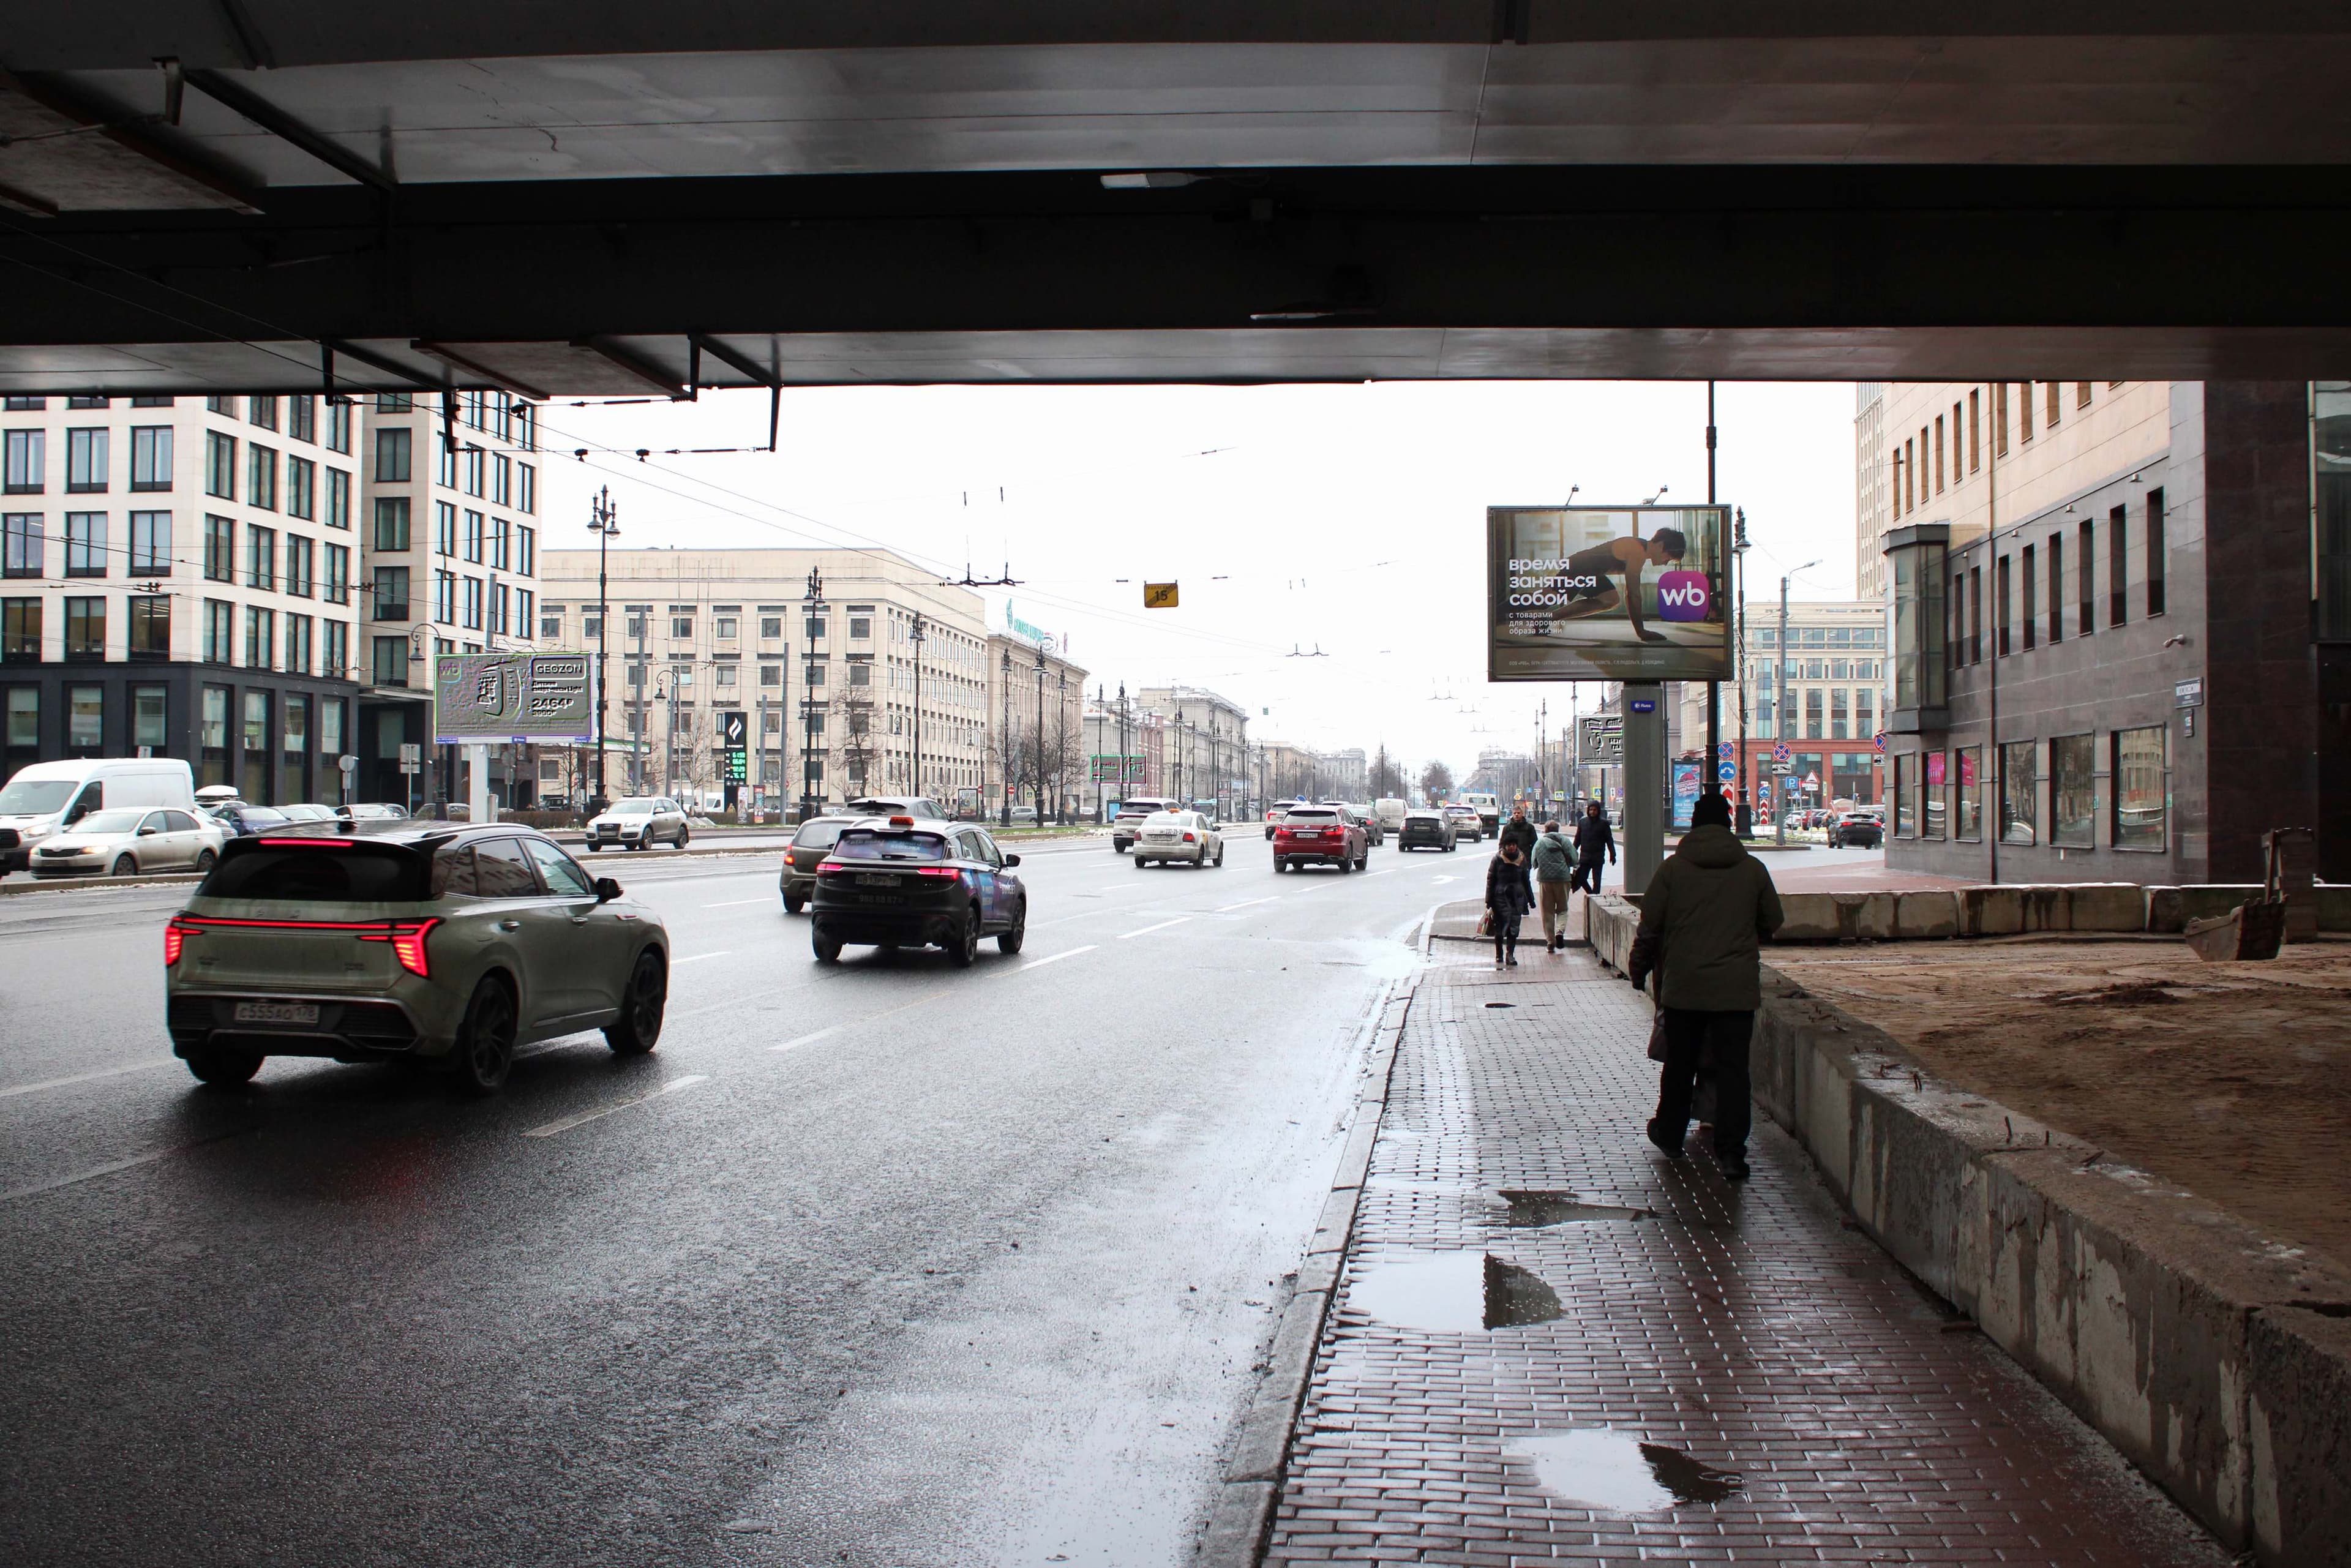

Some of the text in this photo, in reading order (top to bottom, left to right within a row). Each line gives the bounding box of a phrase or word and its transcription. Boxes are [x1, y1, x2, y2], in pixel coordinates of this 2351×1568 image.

[1509, 558, 1570, 574] время
[1509, 576, 1597, 588] заняться
[1155, 590, 1168, 601] 15
[1509, 589, 1568, 606] собой
[1660, 581, 1706, 606] wb
[1509, 627, 1536, 636] образа
[438, 662, 459, 676] wb
[536, 664, 582, 674] GEOZON
